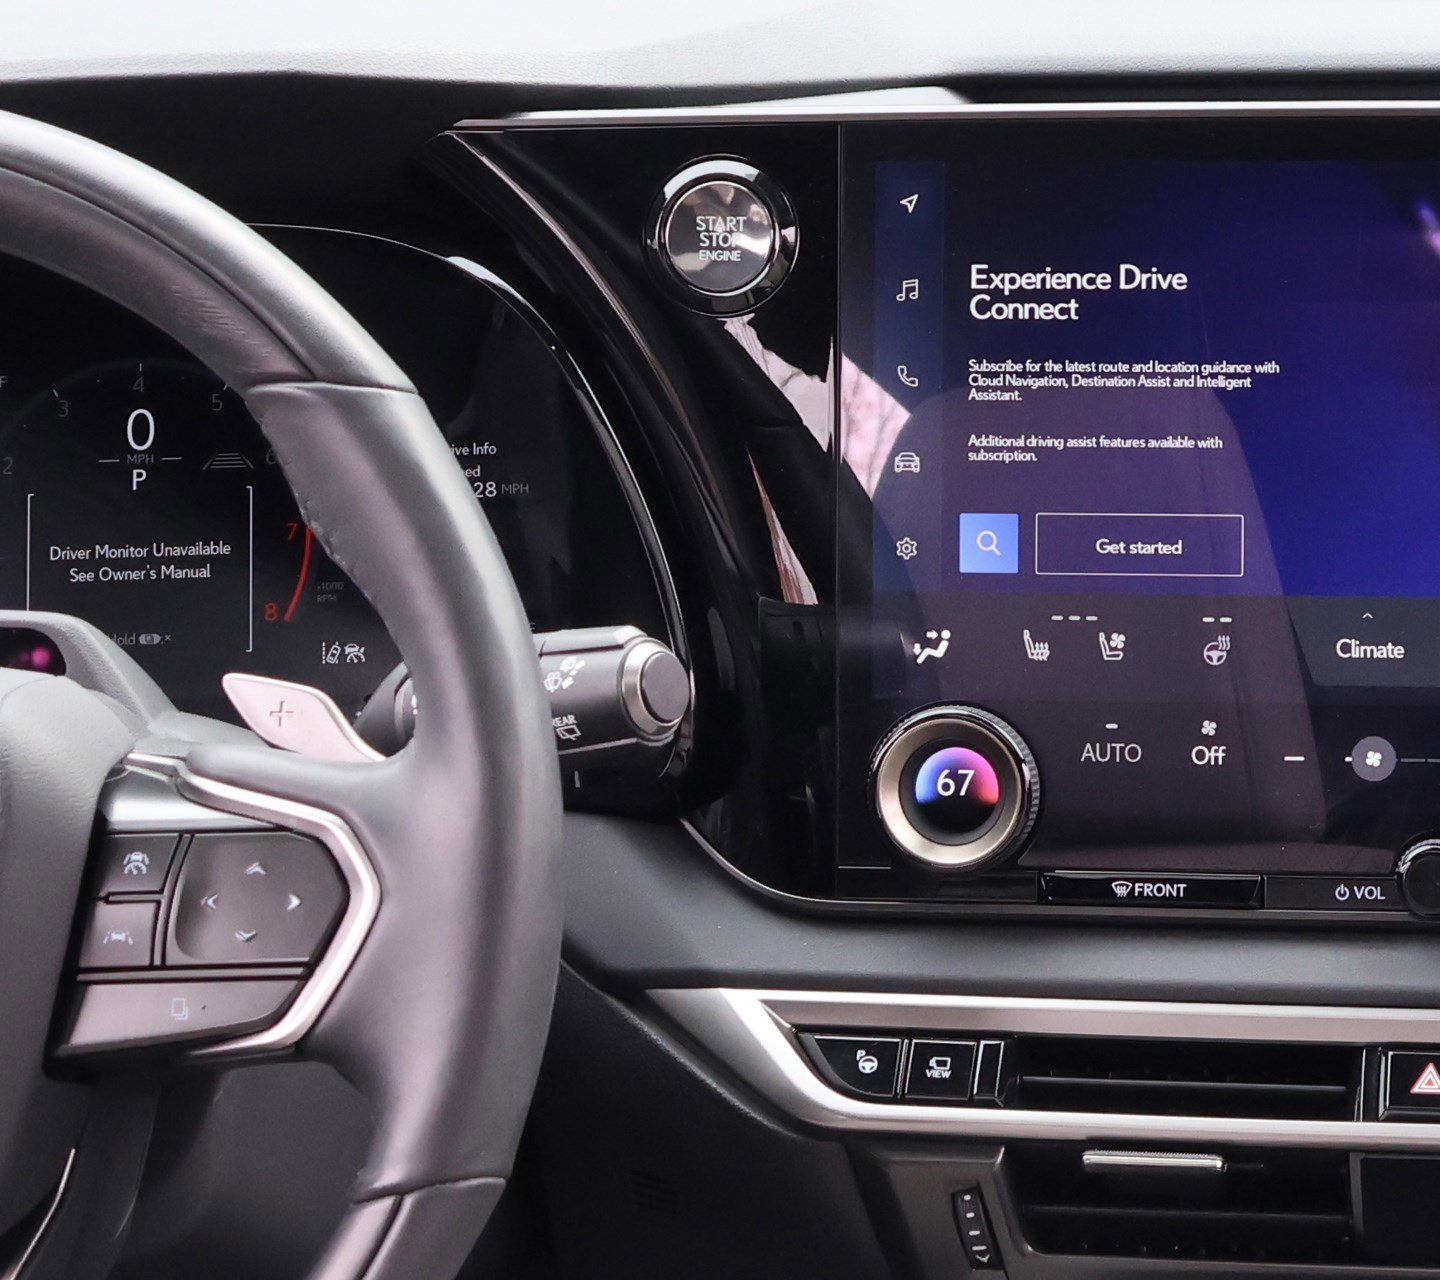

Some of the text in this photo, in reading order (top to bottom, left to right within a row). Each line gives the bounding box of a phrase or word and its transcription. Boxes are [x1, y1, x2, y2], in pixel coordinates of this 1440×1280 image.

[696, 216, 747, 232] START
[700, 232, 742, 247] STOP
[699, 250, 741, 261] ENGINE
[971, 264, 1188, 295] Experience Drive
[970, 294, 1079, 320] Connect
[968, 359, 1280, 376] Subscribe for the latest route and location guidance with
[968, 373, 1252, 390] Cloud Navigation, Destination Assist and Intelligent
[968, 388, 1022, 401] Assistant.
[127, 408, 155, 451] 0
[451, 442, 497, 456] ive Info
[968, 434, 1223, 450] Additional driving assist features available with
[127, 453, 154, 465] MPH
[968, 449, 1038, 463] subscription.
[132, 469, 147, 491] P
[502, 483, 529, 495] MPH
[287, 523, 298, 541] 7
[50, 541, 231, 561] Driver Monitor Unavailable
[1095, 538, 1182, 555] Get started
[70, 563, 210, 582] See Owner's Manual
[264, 602, 278, 621] 8
[1336, 638, 1405, 660] Climate
[1080, 743, 1143, 764] AUTO
[1190, 745, 1227, 766] Off
[936, 769, 975, 797] 67
[1134, 882, 1187, 899] FRONT
[1353, 885, 1386, 901] VOL
[925, 1069, 952, 1078] VIEW
